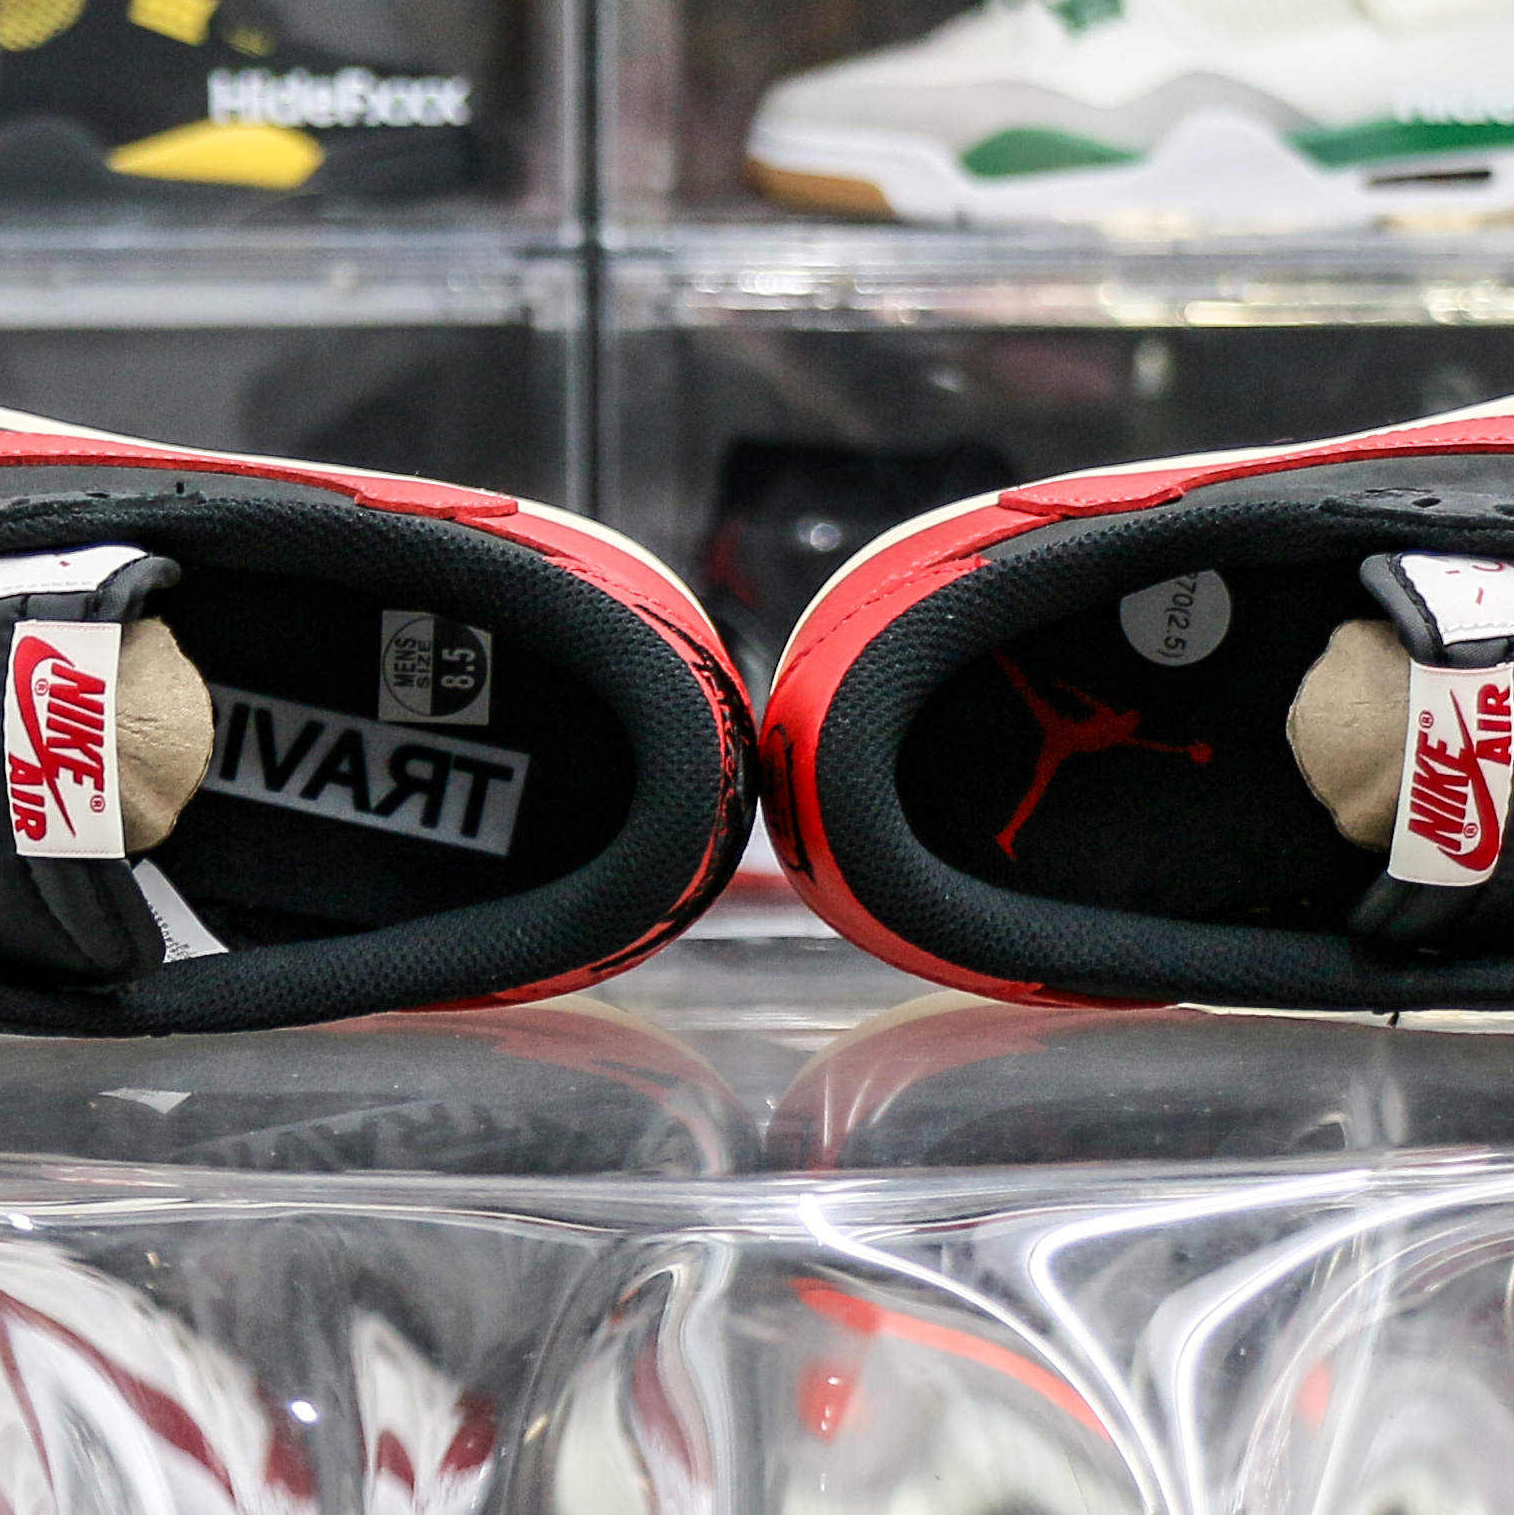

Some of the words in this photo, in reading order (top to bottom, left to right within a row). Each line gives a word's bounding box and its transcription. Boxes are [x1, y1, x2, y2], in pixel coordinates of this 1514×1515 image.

[393, 637, 417, 688] MENS
[416, 639, 432, 689] SIZE
[440, 647, 476, 690] 8.5
[46, 661, 107, 793] NIKE
[1475, 682, 1512, 766] AIR
[7, 753, 48, 842] AIR
[1407, 730, 1471, 853] NIKE
